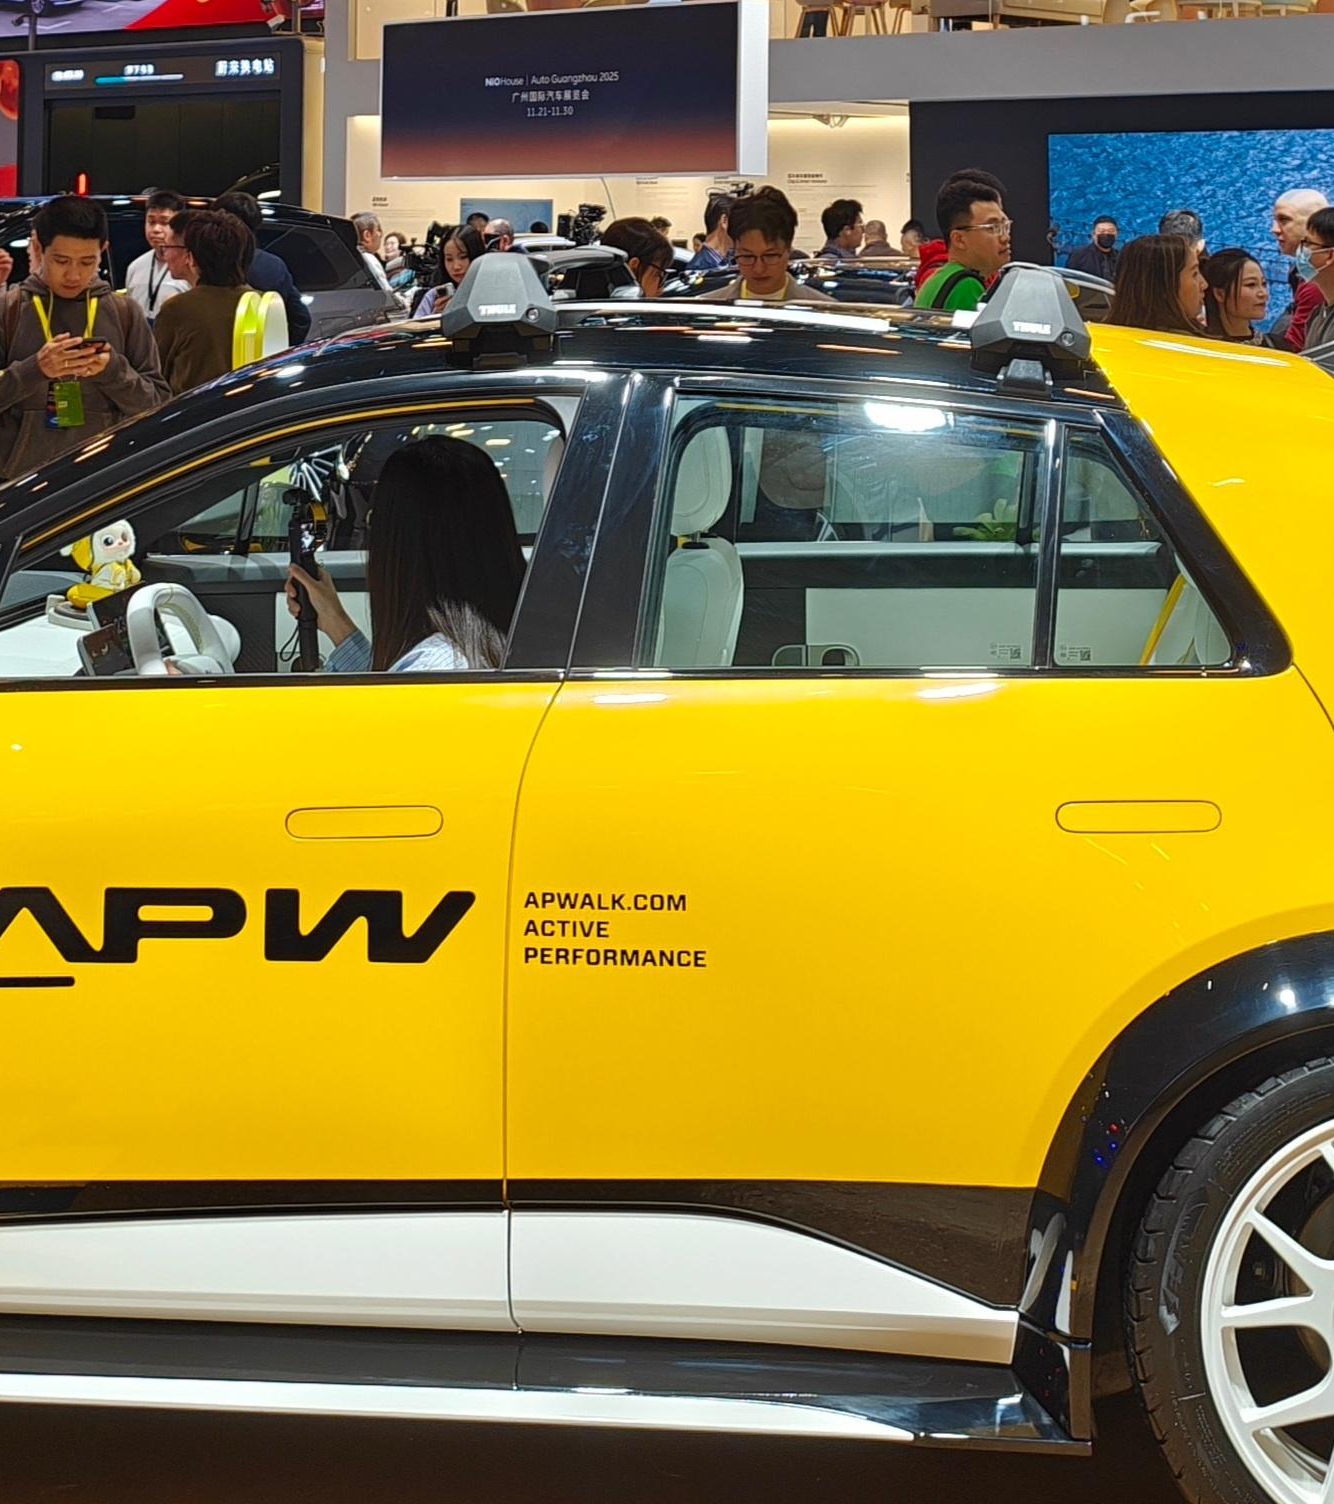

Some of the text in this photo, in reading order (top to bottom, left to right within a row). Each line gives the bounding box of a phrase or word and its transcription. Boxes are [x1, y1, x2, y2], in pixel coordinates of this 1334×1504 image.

[531, 74, 550, 85] Auto
[551, 72, 598, 86] Guangzhou
[599, 71, 620, 82] 2025
[511, 88, 590, 104] 广州国际汽车展览会
[526, 105, 574, 118] 11.21-11.30
[523, 891, 687, 912] APWALK.COM
[523, 919, 610, 938] ACTIVE
[523, 946, 707, 968] PERFORMANCE
